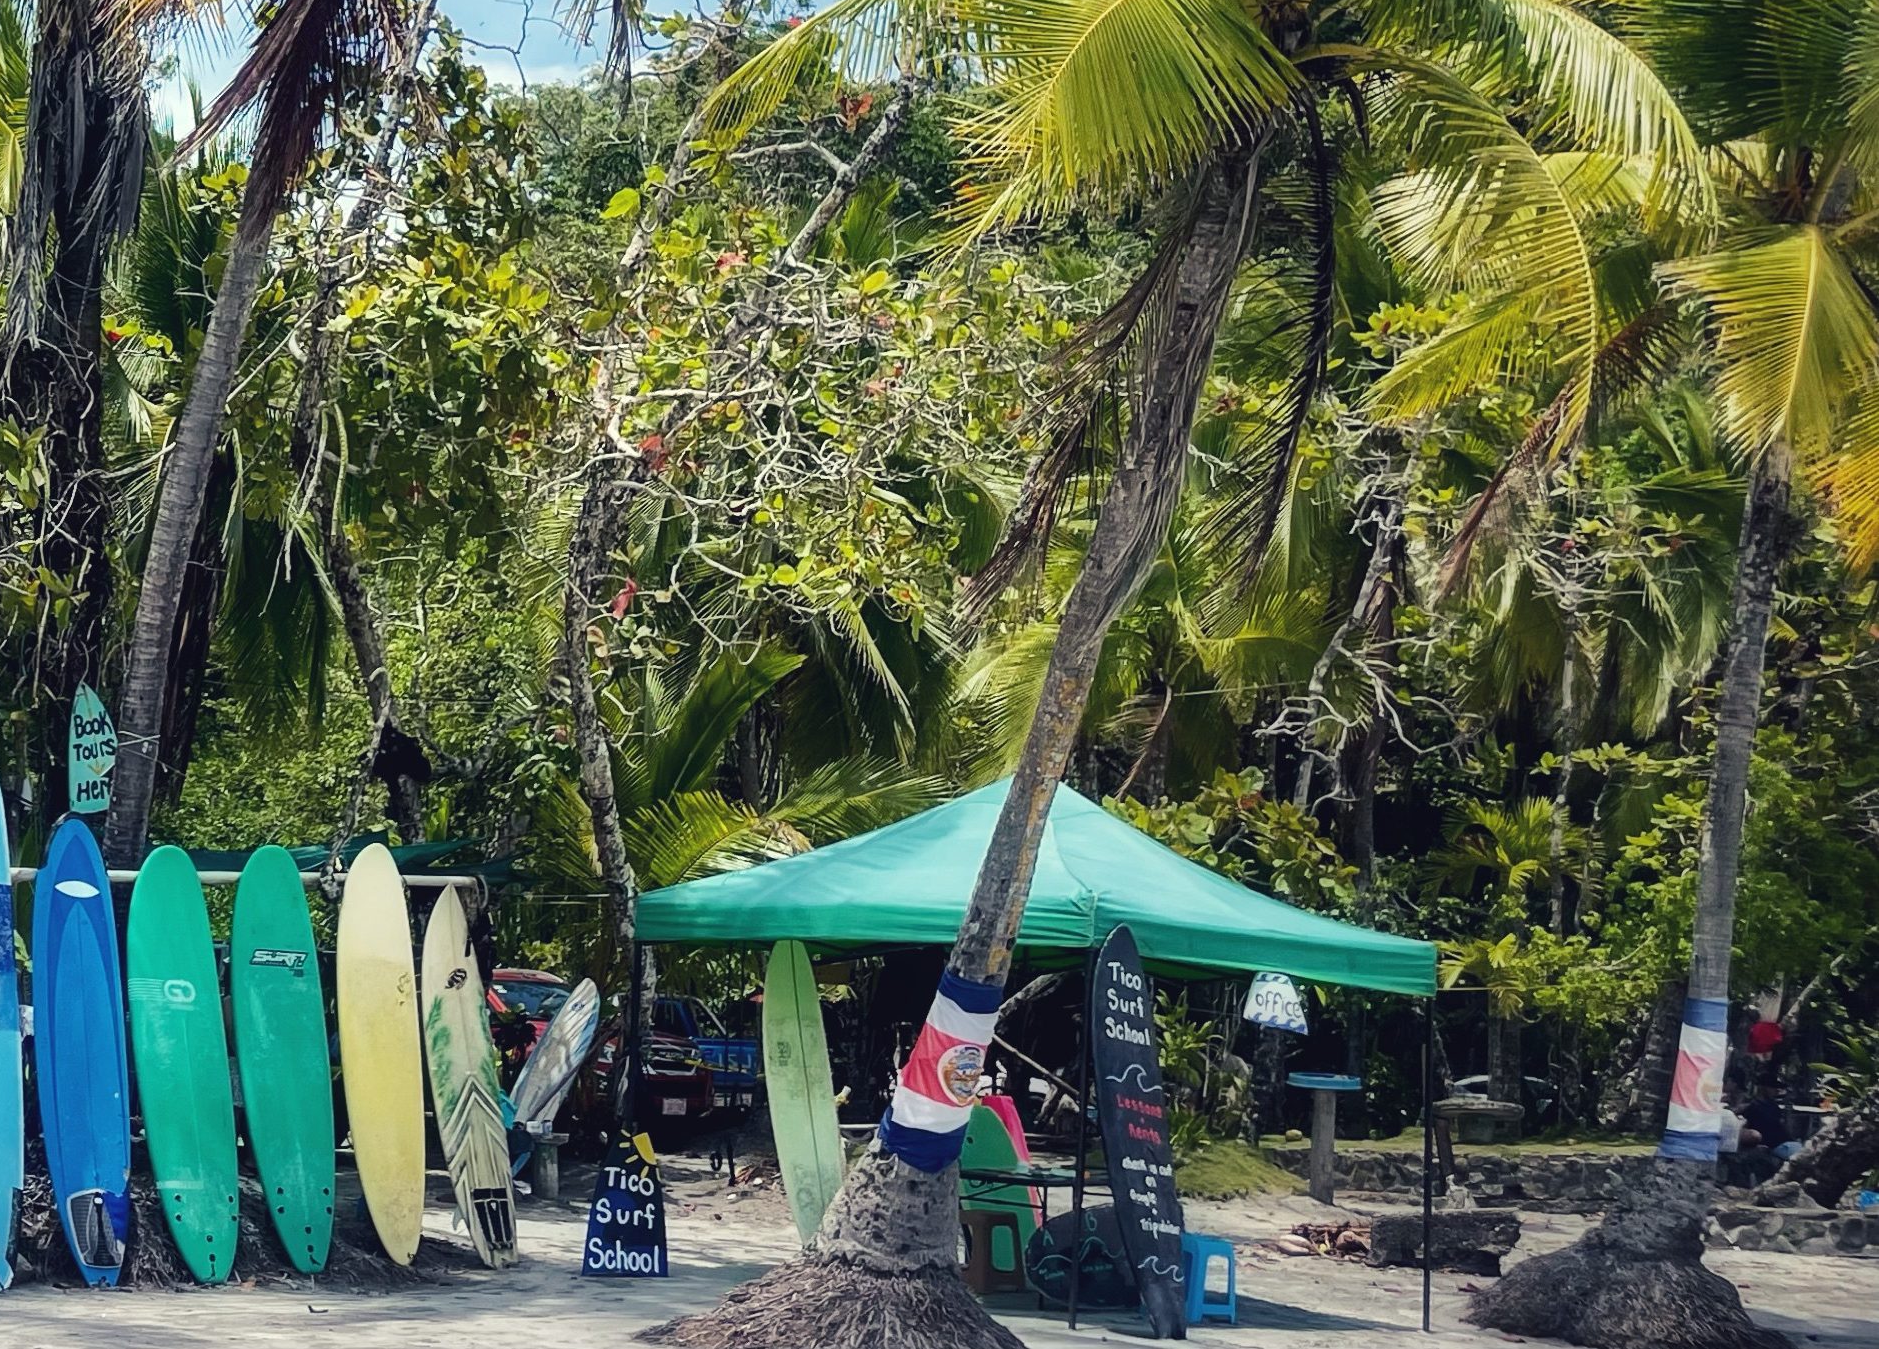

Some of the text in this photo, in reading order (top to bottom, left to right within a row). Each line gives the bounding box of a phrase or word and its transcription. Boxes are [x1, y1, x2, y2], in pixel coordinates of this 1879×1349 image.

[77, 779, 111, 802] Her
[1107, 961, 1141, 991] Tico
[1107, 987, 1144, 1018] Surf
[1255, 990, 1302, 1019] office
[1104, 1016, 1151, 1046] School
[604, 1166, 655, 1196] Tico
[595, 1197, 656, 1230] Surf
[588, 1237, 660, 1274] School
